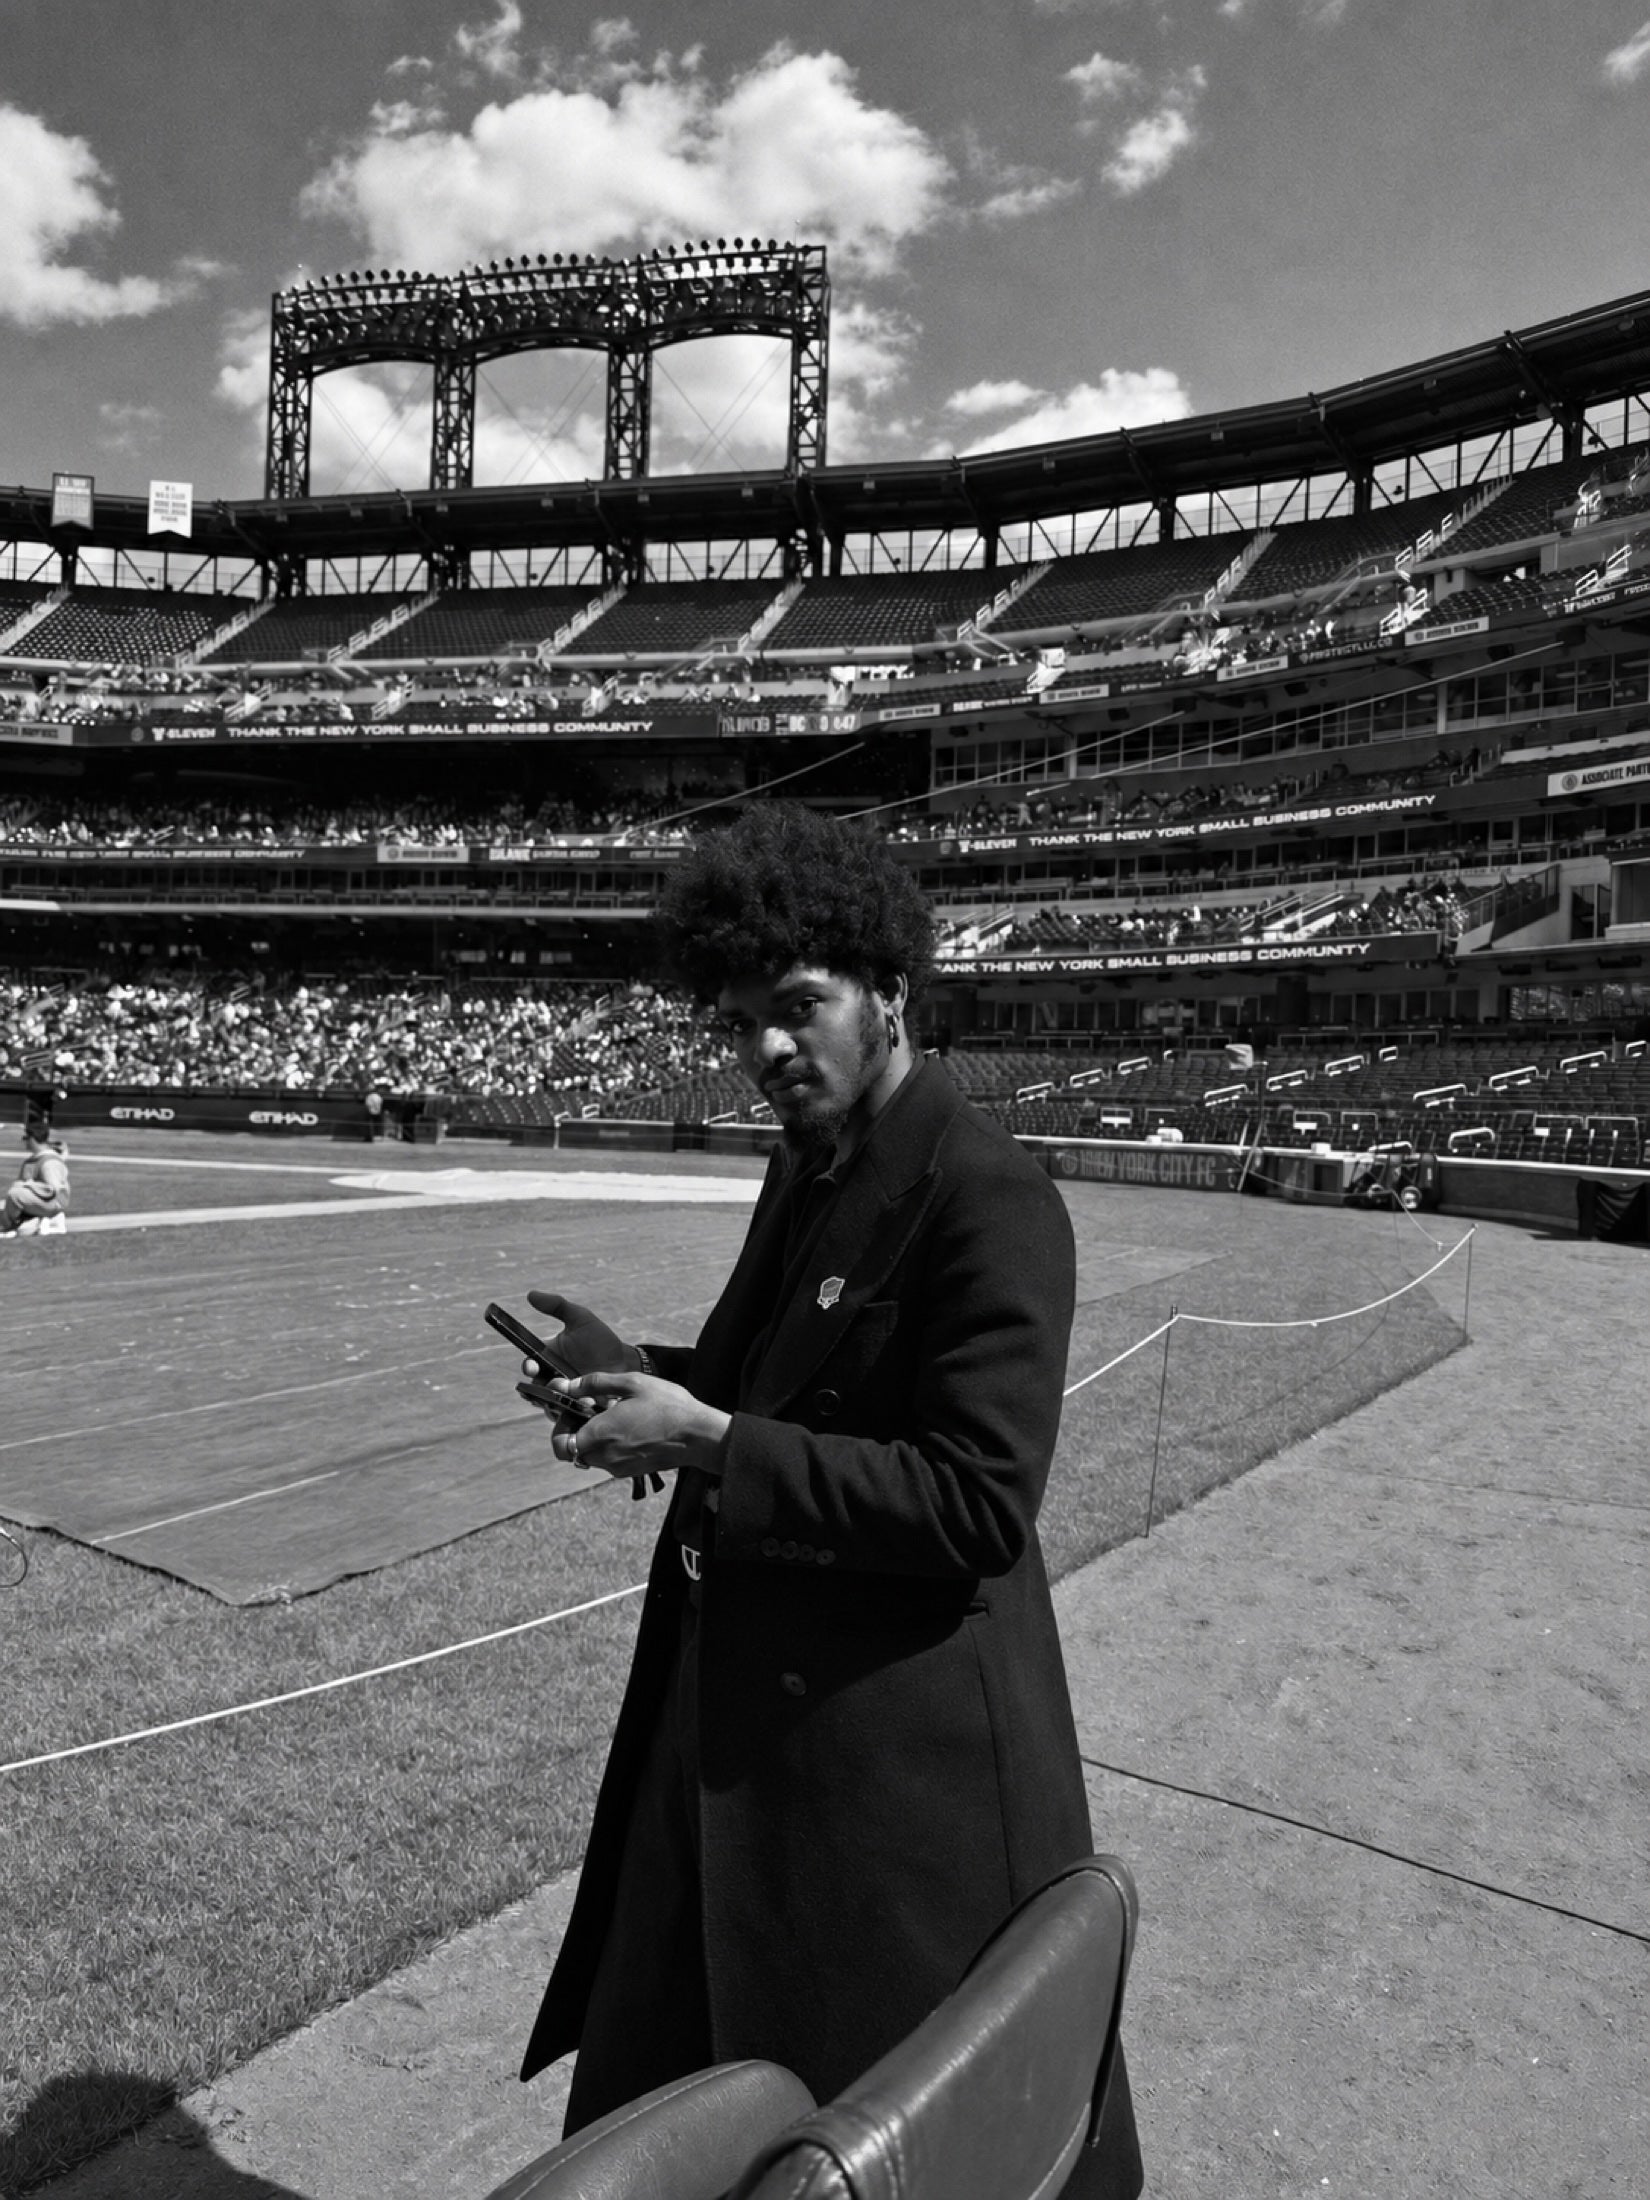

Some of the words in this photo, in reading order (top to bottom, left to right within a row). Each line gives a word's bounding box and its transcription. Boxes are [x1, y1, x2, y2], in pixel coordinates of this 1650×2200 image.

[227, 727, 281, 737] THANK
[286, 726, 317, 736] THE
[320, 725, 357, 736] NEW
[361, 724, 404, 735] YORK
[409, 724, 463, 734] SMALL
[467, 722, 549, 734] BUSINESS
[553, 721, 653, 733] COMMUNITY
[1029, 834, 1080, 846] THANK
[1083, 832, 1113, 842] THE
[1117, 829, 1152, 840] NEW
[1155, 825, 1195, 838] YORK
[1199, 818, 1249, 833] SMALL
[1253, 808, 1331, 826] BUSINESS
[1335, 795, 1436, 816] COMMUNITY
[980, 961, 1012, 972] THE
[1015, 960, 1055, 972] NEW
[1059, 959, 1104, 970] YORK
[1107, 957, 1162, 969] SMALL
[1166, 951, 1252, 966] BUSINESS
[1256, 943, 1371, 960] COMMUNITY
[110, 1107, 175, 1120] ETIHAD
[249, 1110, 318, 1125] ETIHAD
[1117, 1151, 1157, 1182] YORK
[1158, 1153, 1194, 1185] CITY
[1196, 1156, 1217, 1187] FC
